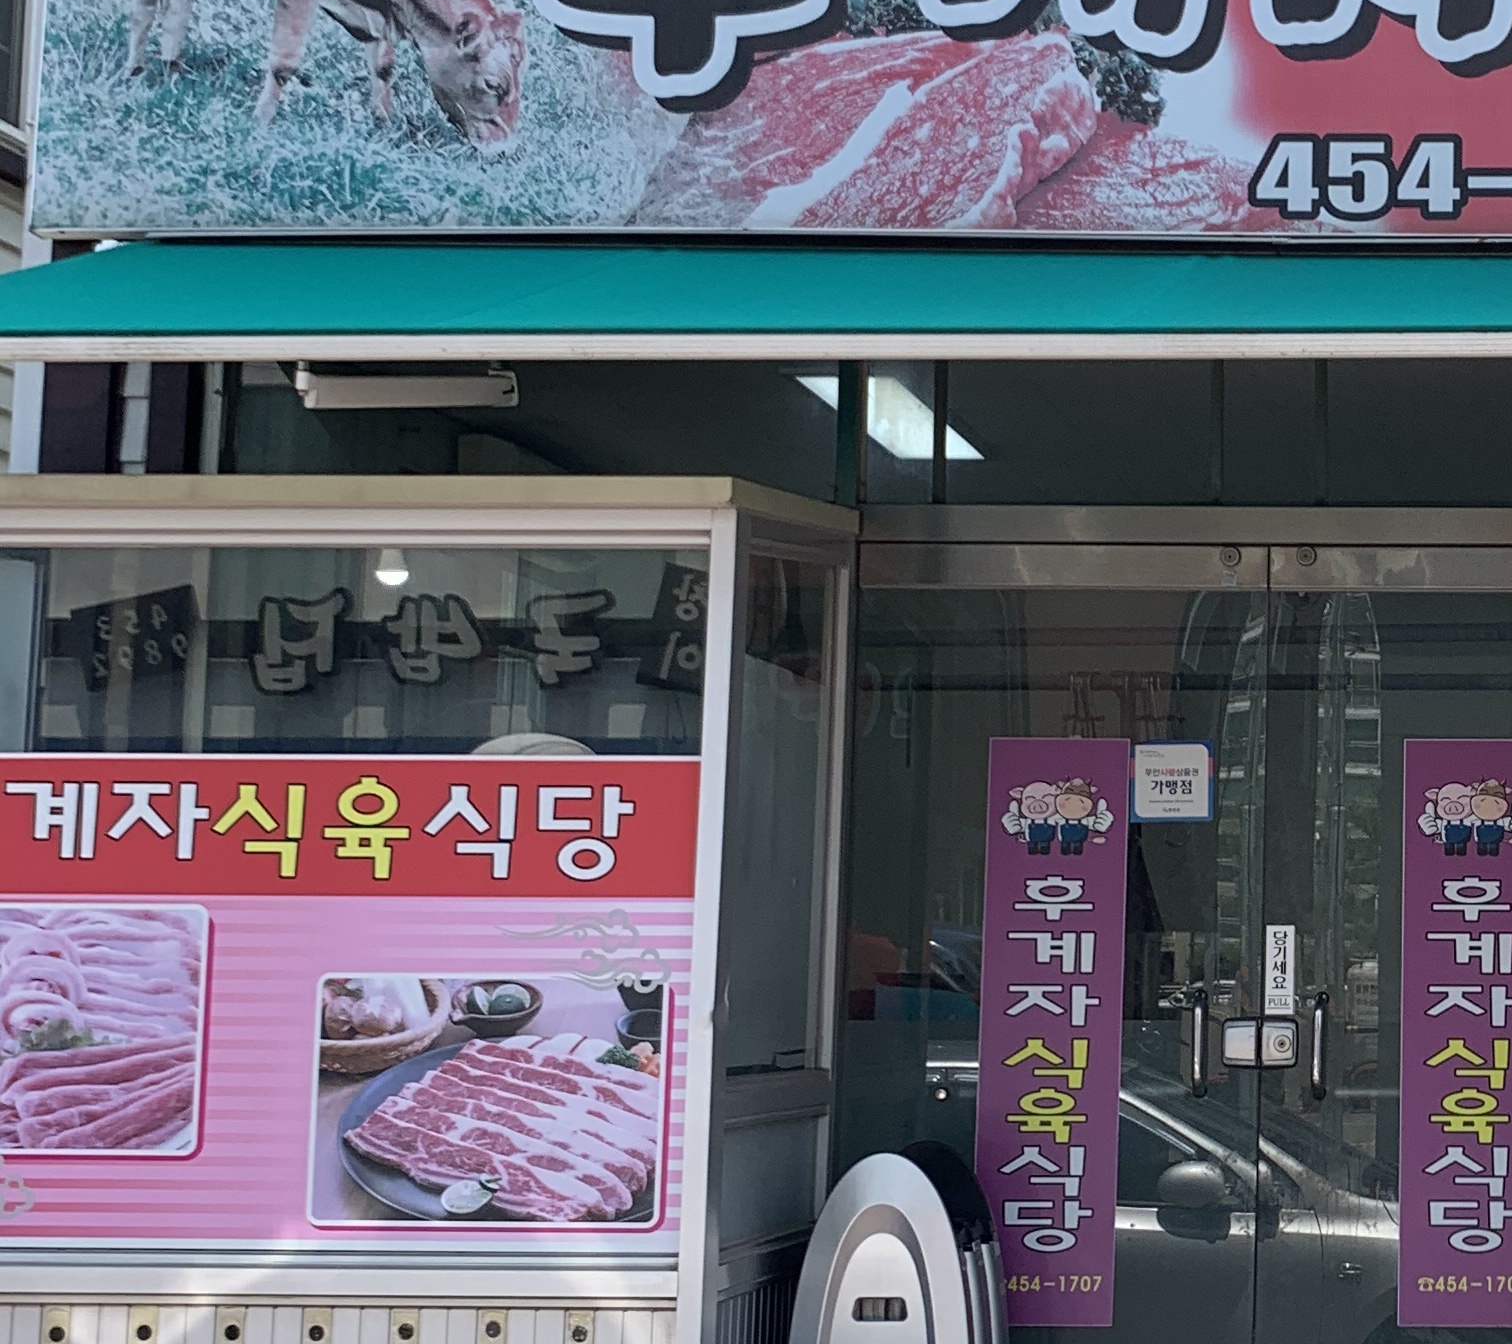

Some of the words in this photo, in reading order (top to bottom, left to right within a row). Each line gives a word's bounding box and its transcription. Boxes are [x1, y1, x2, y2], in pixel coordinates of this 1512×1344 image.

[1151, 780, 1193, 795] 가맹점
[3, 775, 637, 882] 계자식육식당
[1271, 930, 1288, 990] 당기세요
[1268, 997, 1290, 1007] PULL
[998, 875, 1101, 1253] 후계자식육식당
[1008, 1275, 1102, 1292] 454-1707
